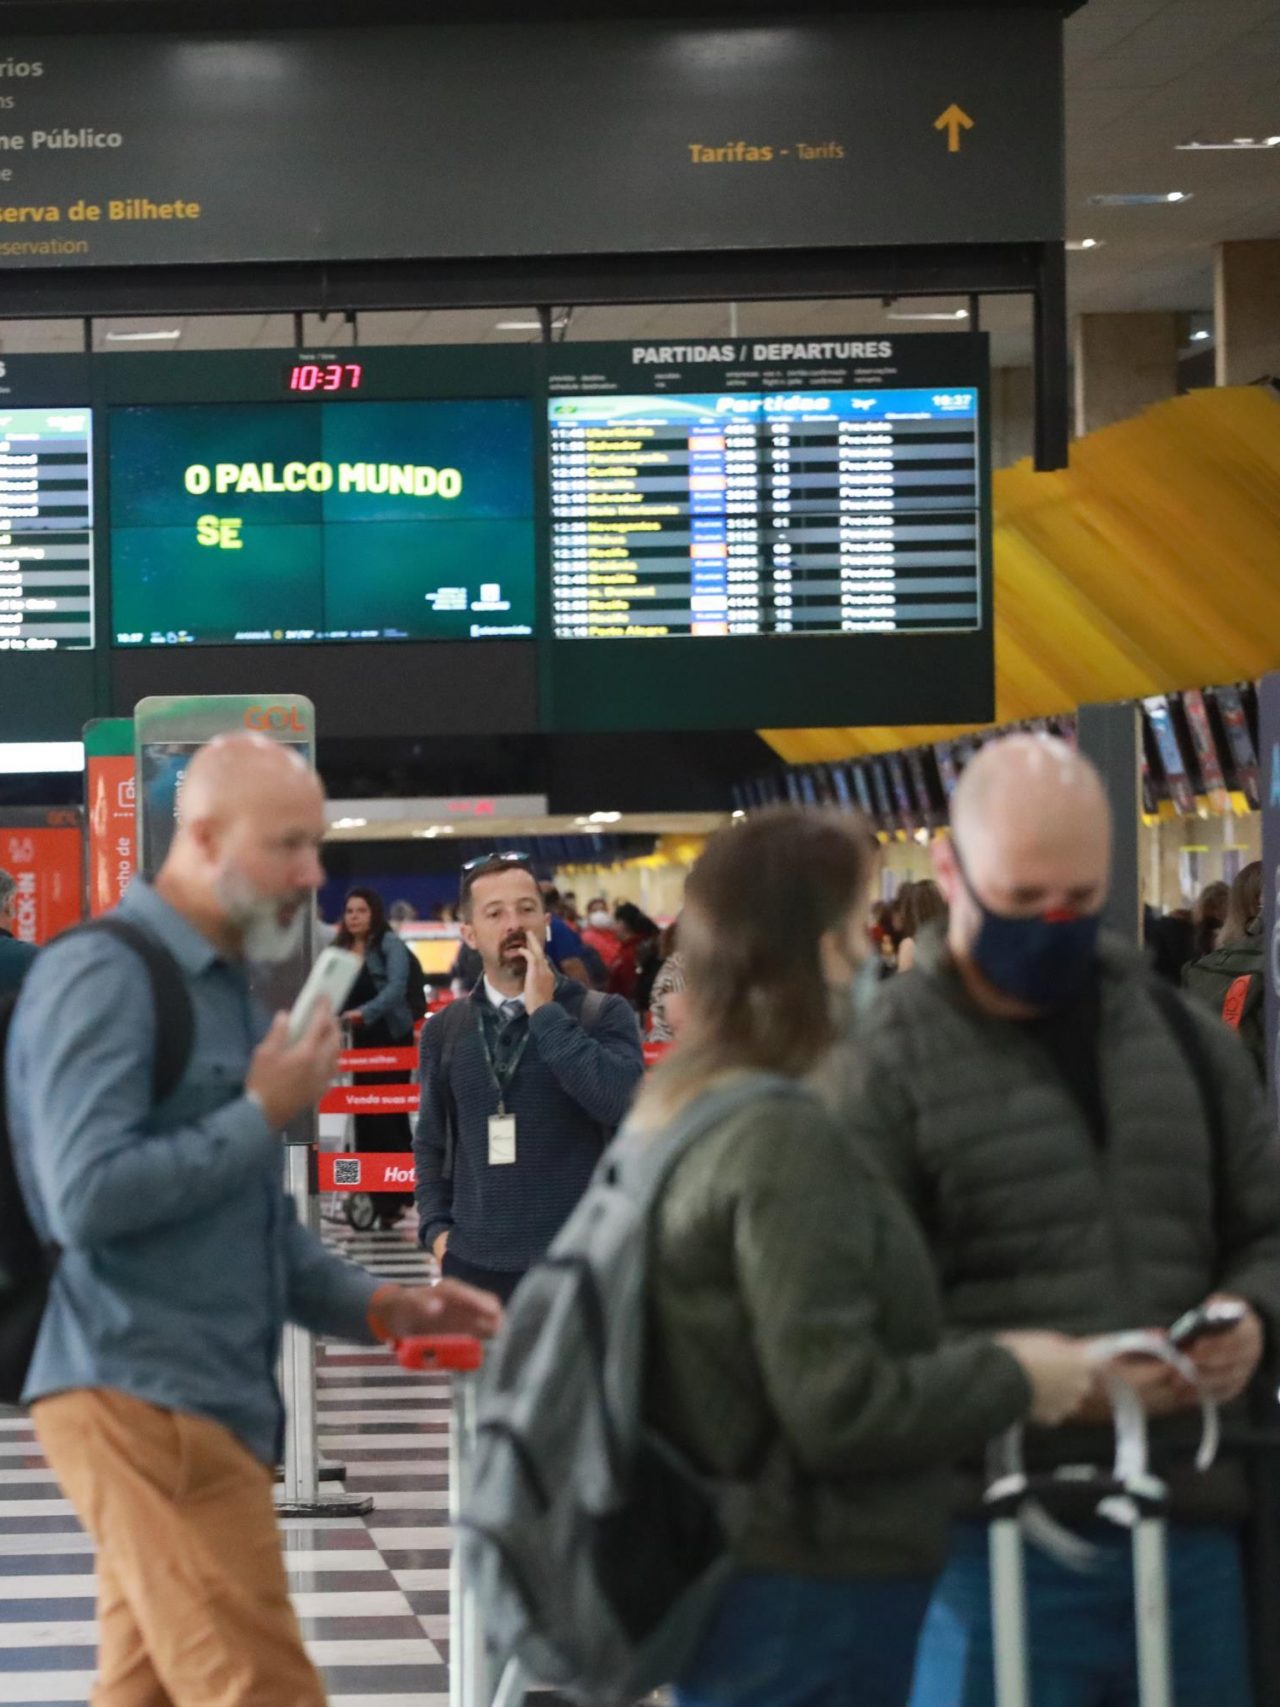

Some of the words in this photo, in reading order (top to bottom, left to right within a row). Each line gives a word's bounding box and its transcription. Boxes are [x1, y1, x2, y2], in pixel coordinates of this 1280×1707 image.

[31, 128, 122, 150] Público
[688, 141, 773, 163] Tarifas
[796, 141, 845, 160] Tarifs
[67, 202, 101, 222] de
[109, 199, 201, 221] Bilhete
[632, 346, 735, 364] PARTIDAS
[754, 342, 892, 361] DEPARTURES
[290, 365, 362, 390] 10:37
[715, 396, 830, 412] Partidas
[184, 464, 210, 494] O
[216, 462, 333, 493] PALCO
[339, 463, 462, 498] MUNDO
[196, 514, 243, 549] SE
[244, 706, 305, 732] GOL
[116, 837, 130, 856] de
[384, 1166, 417, 1184] Hot
